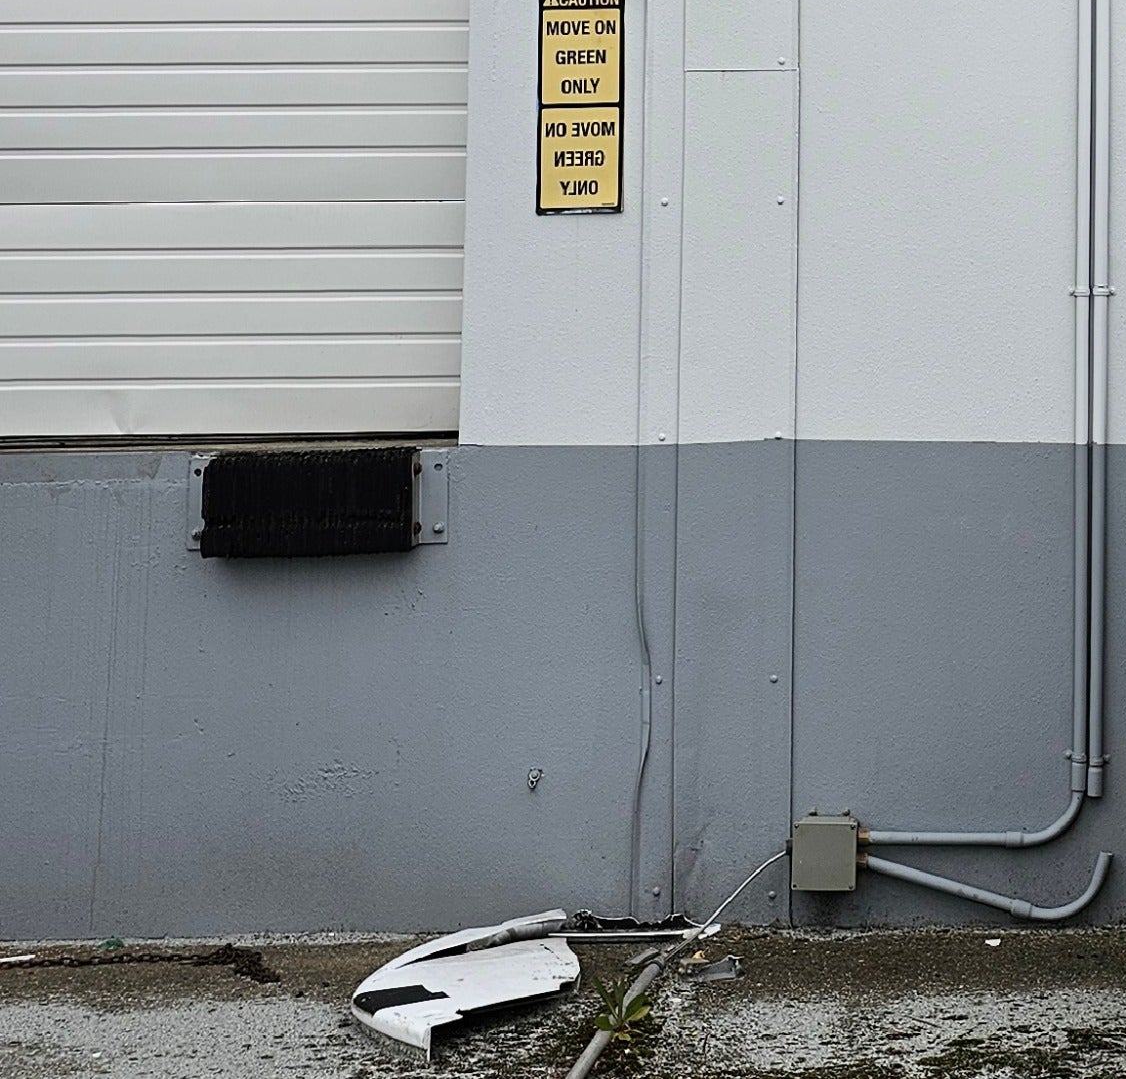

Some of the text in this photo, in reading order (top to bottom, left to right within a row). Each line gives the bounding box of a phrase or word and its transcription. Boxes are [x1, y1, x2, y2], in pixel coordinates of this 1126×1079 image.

[546, 19, 617, 36] MOVE ON
[555, 49, 607, 65] GREEN
[560, 78, 601, 94] ONLY
